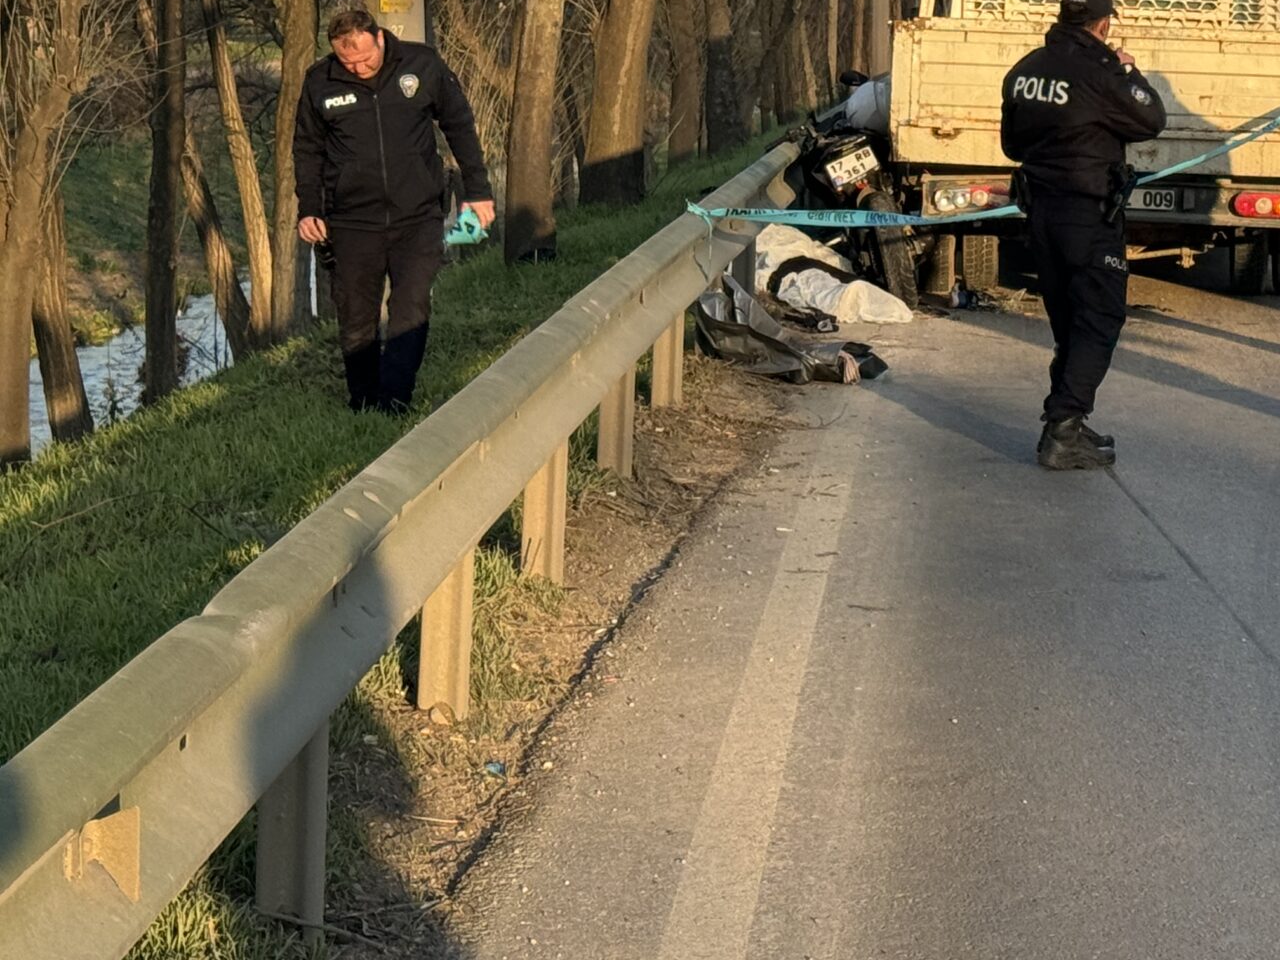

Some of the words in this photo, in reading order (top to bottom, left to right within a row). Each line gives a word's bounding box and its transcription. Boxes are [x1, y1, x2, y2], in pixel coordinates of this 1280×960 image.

[830, 161, 844, 174] 17
[843, 162, 867, 180] 361
[1143, 191, 1174, 208] 009
